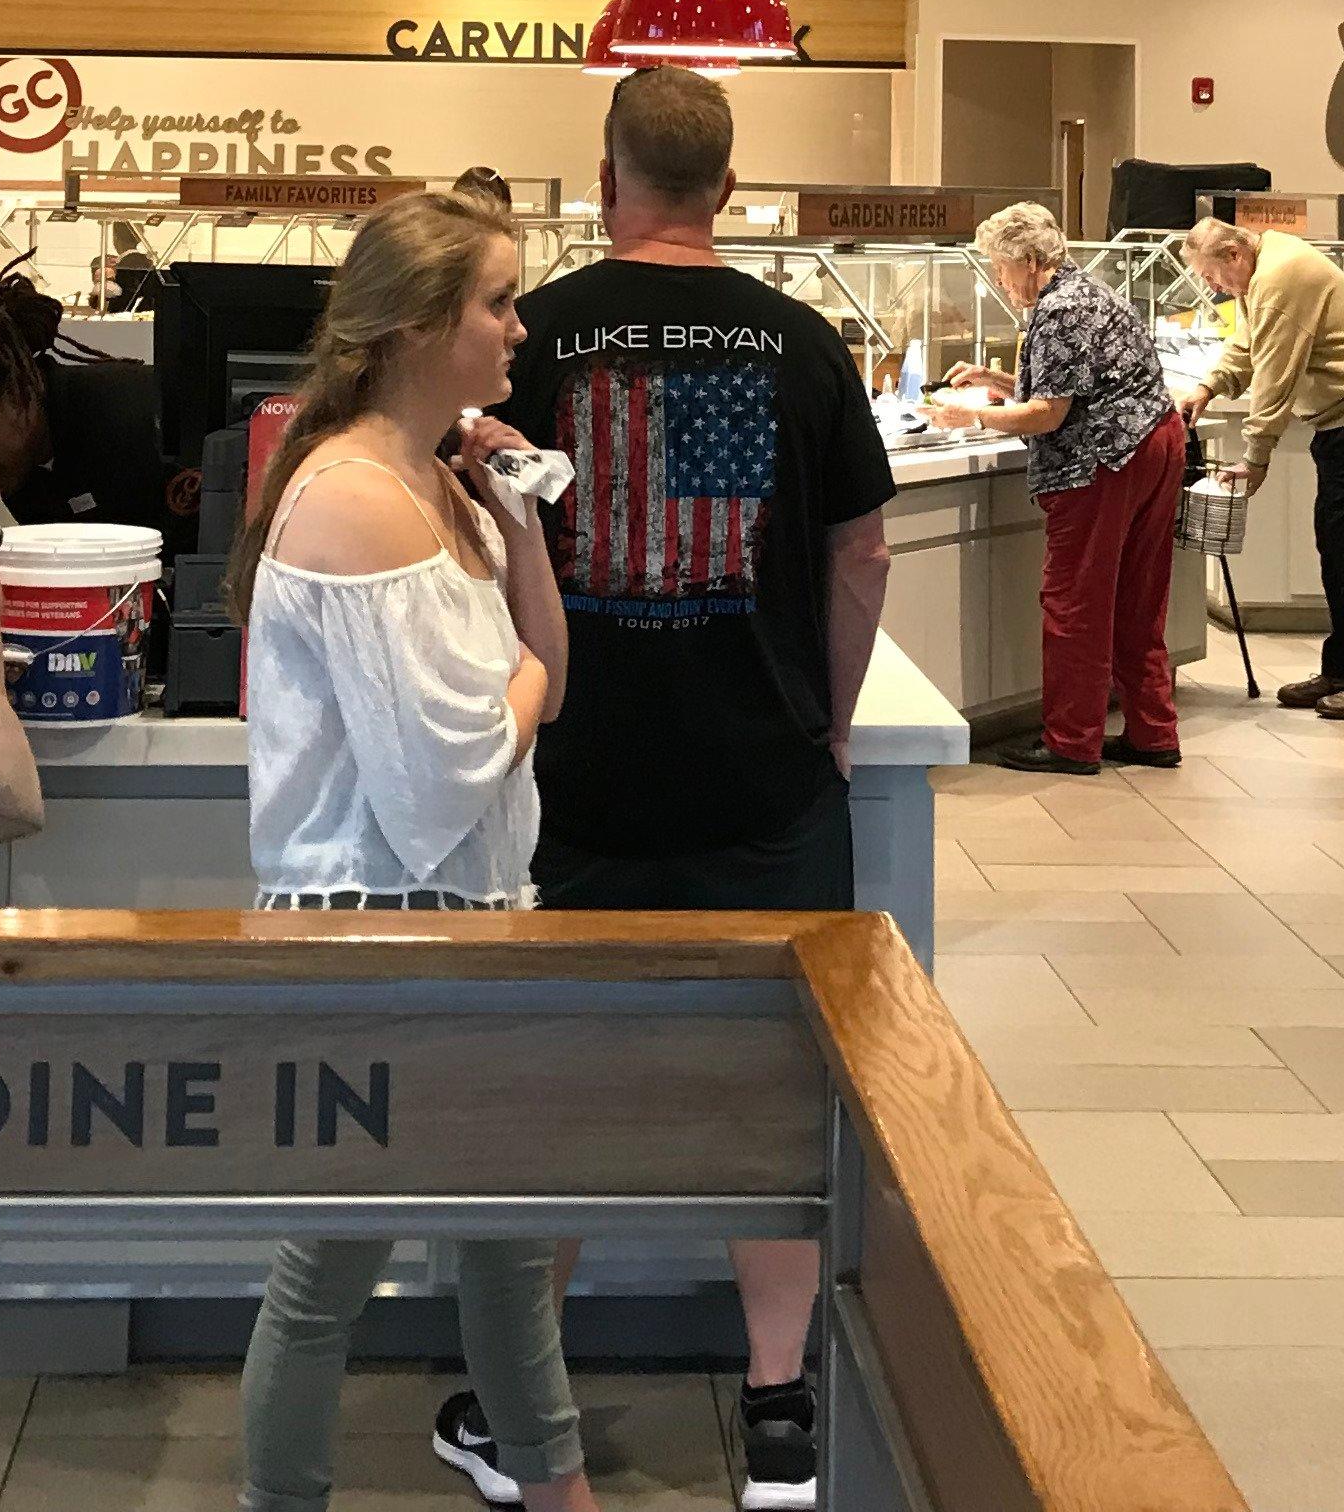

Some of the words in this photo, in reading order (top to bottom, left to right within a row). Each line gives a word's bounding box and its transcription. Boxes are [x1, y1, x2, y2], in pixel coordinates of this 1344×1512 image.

[386, 20, 585, 61] CARVIN
[65, 106, 139, 140] Help
[142, 109, 264, 144] yourself
[271, 109, 301, 135] to
[63, 140, 393, 180] HAPPINESS
[225, 185, 281, 202] FAMILY
[287, 186, 377, 205] FAVORITES
[828, 203, 895, 228] GARDEN
[899, 204, 947, 229] FRESH
[556, 324, 649, 360] LUKE
[663, 325, 783, 355] BRYAN
[260, 402, 300, 416] NOW
[617, 617, 663, 630] TOUR
[672, 616, 710, 630] 2017
[48, 652, 97, 672] DAV
[276, 1061, 390, 1149] IN
